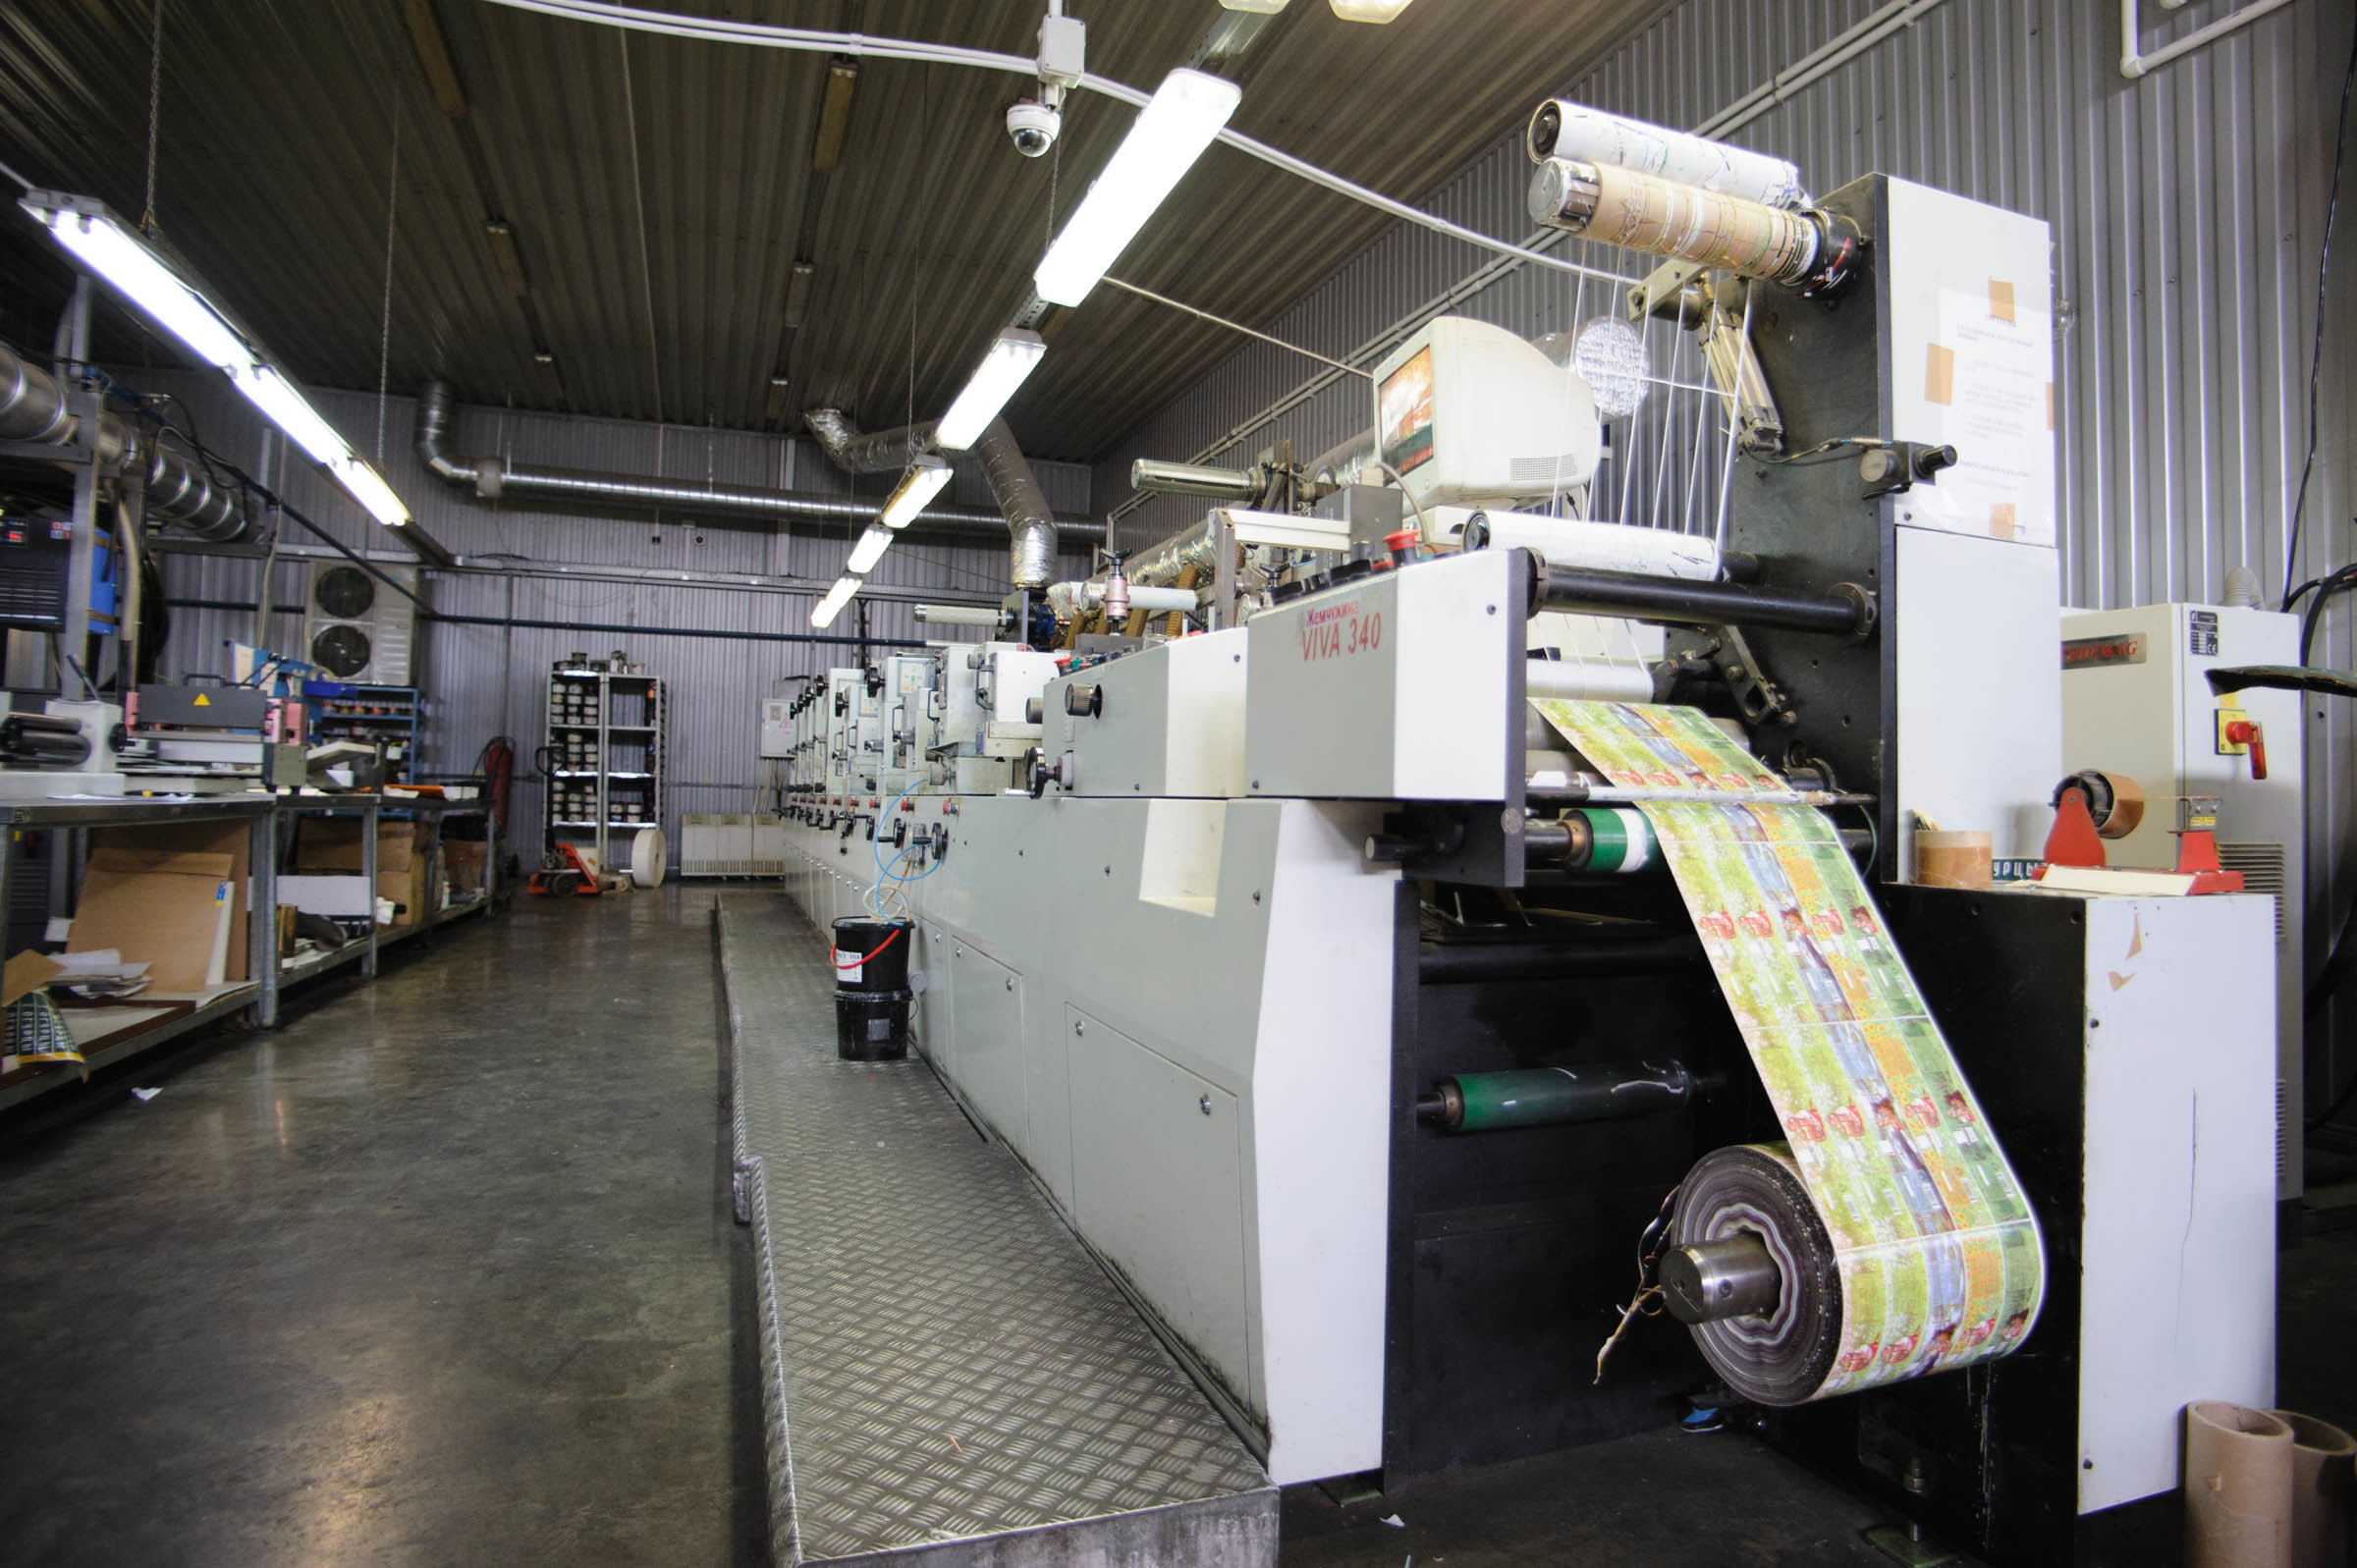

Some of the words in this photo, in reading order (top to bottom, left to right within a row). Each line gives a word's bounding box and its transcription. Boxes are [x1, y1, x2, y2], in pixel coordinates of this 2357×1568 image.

[1306, 600, 1359, 627] Жемчужина
[1301, 622, 1340, 662] VIVA
[1347, 613, 1381, 653] 340
